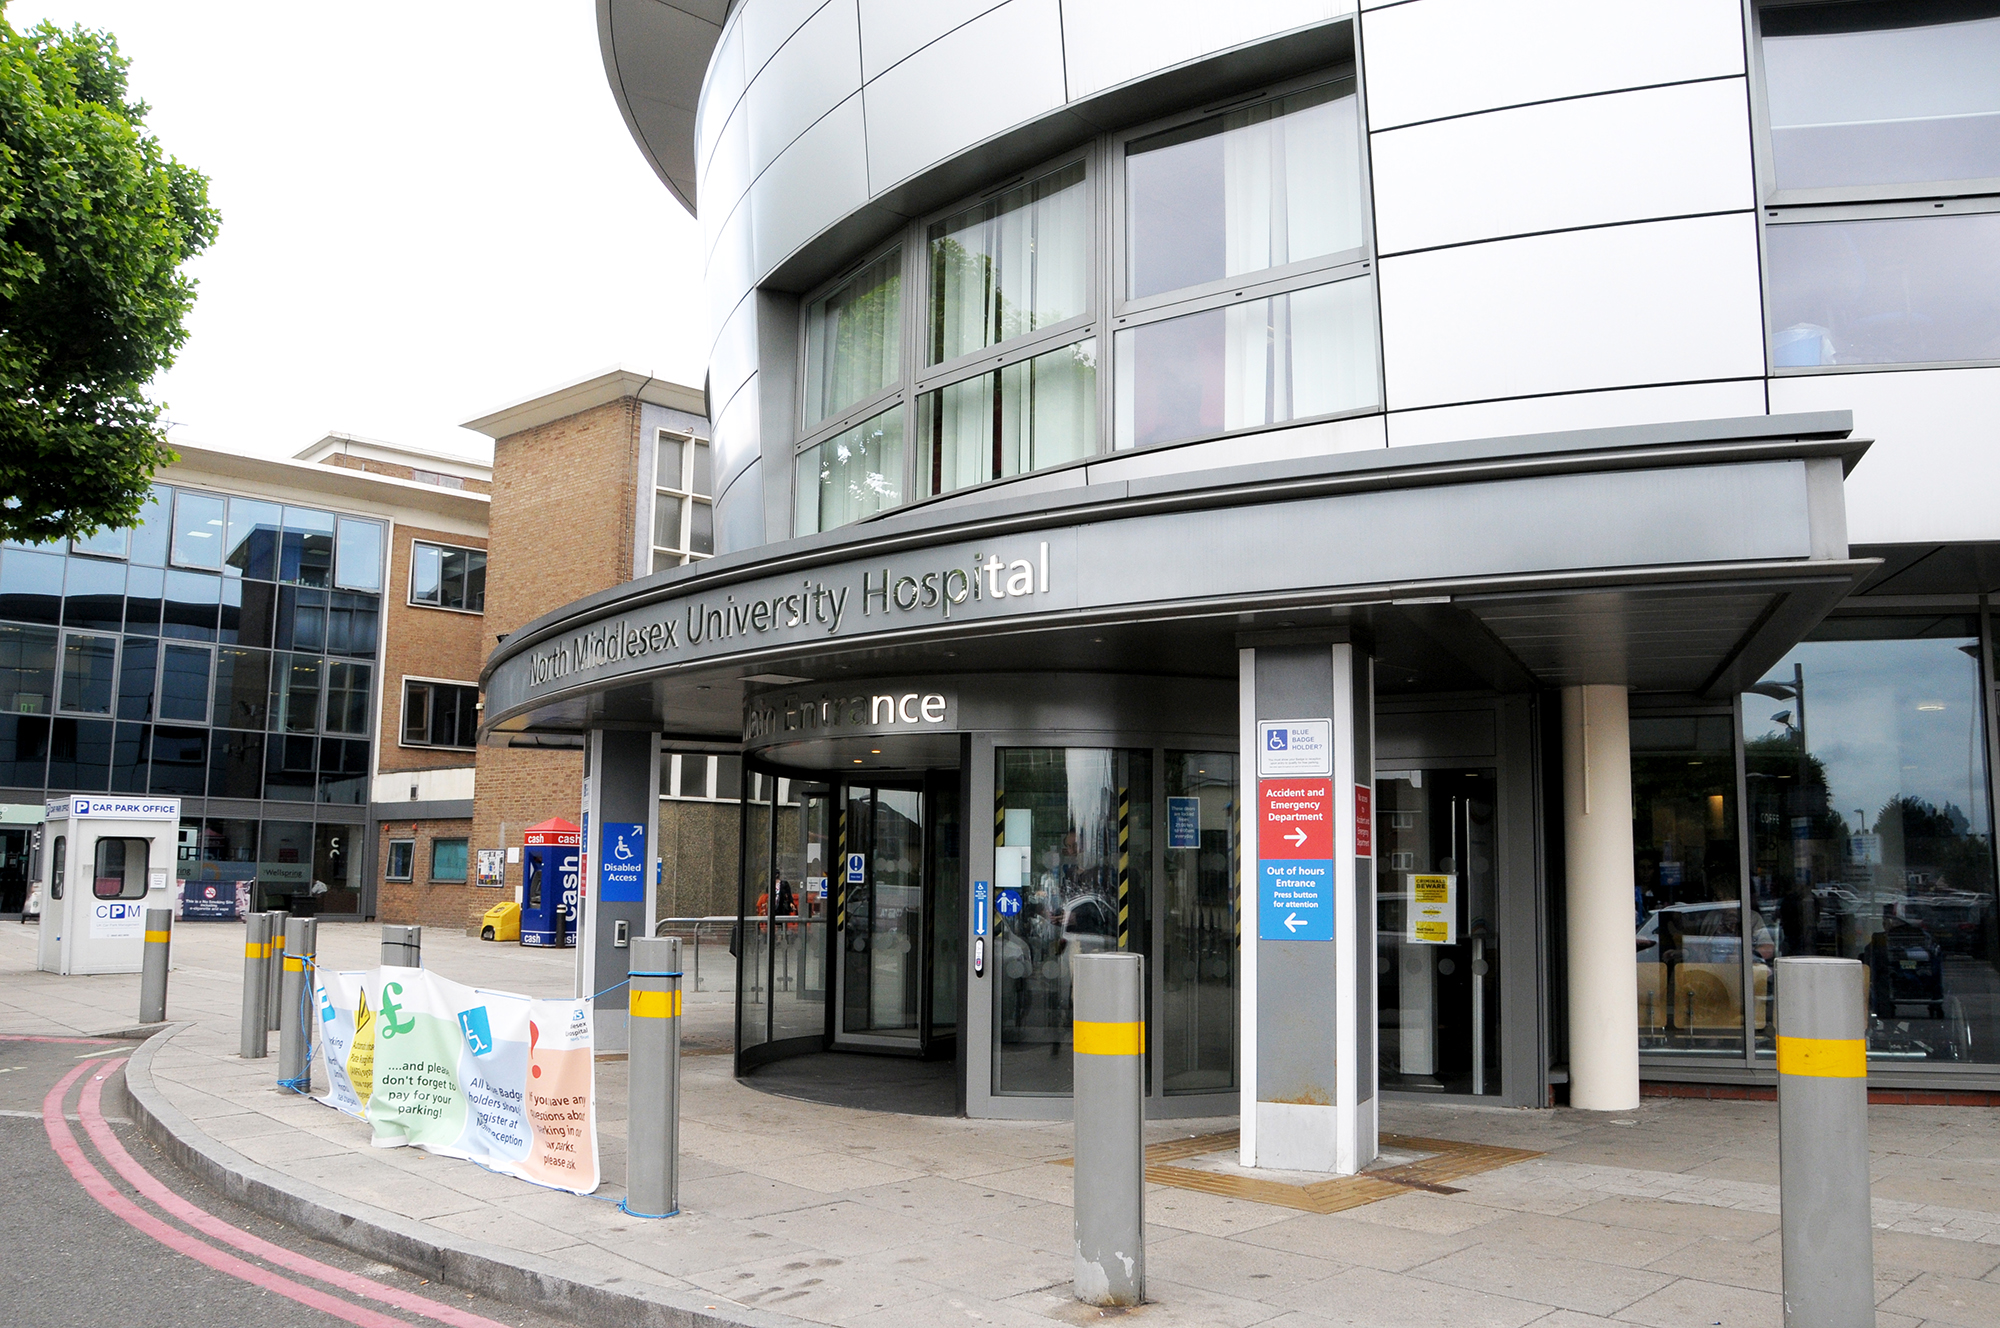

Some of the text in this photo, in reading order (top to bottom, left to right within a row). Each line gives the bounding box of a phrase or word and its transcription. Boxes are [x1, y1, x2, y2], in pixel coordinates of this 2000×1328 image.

[528, 540, 1050, 687] North Middlesex University Hospital
[784, 691, 947, 732] Entrance
[1266, 787, 1325, 798] Accident and
[92, 803, 113, 812] CAR
[115, 804, 141, 812] PARK
[142, 805, 175, 813] OFFICE
[1270, 801, 1321, 811] Emergency
[1268, 812, 1323, 823] Department
[527, 834, 545, 844] cash
[557, 834, 581, 844] cash
[604, 862, 642, 872] Disabled
[1267, 866, 1325, 876] Out of hours
[608, 873, 638, 882] Access
[1275, 878, 1316, 888] Entrance
[559, 856, 578, 922] cash
[1273, 891, 1318, 899] Press button
[1273, 900, 1319, 909] for attention
[524, 933, 541, 944] cash
[382, 1074, 413, 1086] don't
[417, 1076, 447, 1090] forget
[448, 1081, 457, 1091] to
[469, 1077, 485, 1089] All
[388, 1090, 452, 1105] pay for your
[468, 1091, 501, 1109] holders
[572, 1096, 586, 1108] any
[397, 1104, 442, 1119] parking!
[508, 1120, 518, 1129] at
[566, 1124, 574, 1136] in
[491, 1131, 523, 1147] eception
[544, 1153, 566, 1168] please
